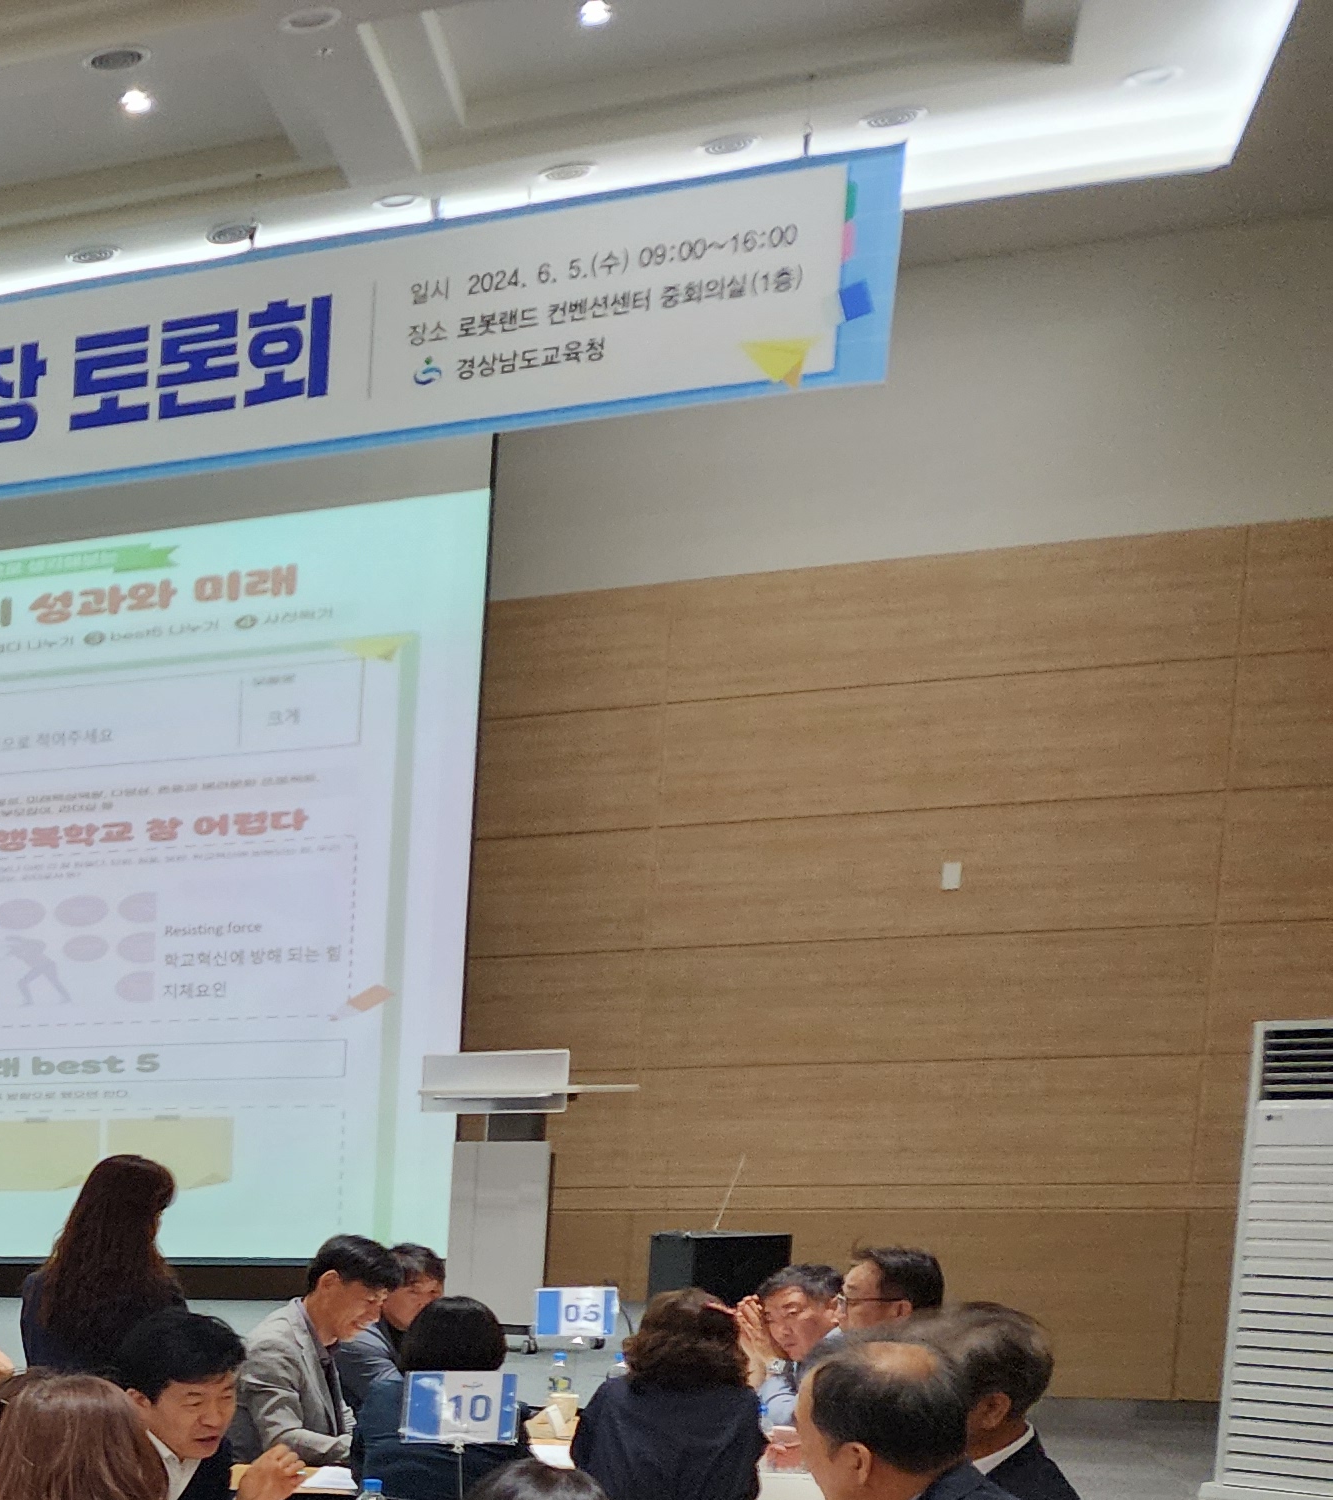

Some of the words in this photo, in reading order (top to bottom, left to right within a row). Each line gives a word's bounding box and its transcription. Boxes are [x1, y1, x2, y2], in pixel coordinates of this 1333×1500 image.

[410, 279, 451, 305] 일시
[467, 268, 528, 296] 2024.
[407, 323, 449, 347] 장소
[456, 308, 539, 340] 로봇랜드
[547, 289, 652, 325] 컨벤션센터
[69, 291, 334, 433] 토론회
[455, 337, 607, 381] 경상남도교육청
[28, 578, 179, 625] 성과와
[193, 563, 299, 602] 미래
[145, 816, 184, 842] 참
[193, 808, 310, 837] 어렵다
[164, 922, 225, 938] Resisting
[226, 921, 263, 936] force
[163, 949, 246, 969] 학교혁신에
[287, 945, 320, 964] 되는
[31, 1054, 126, 1077] best
[136, 1052, 161, 1074] 5
[564, 1303, 602, 1324] 05
[447, 1394, 493, 1423] 10
